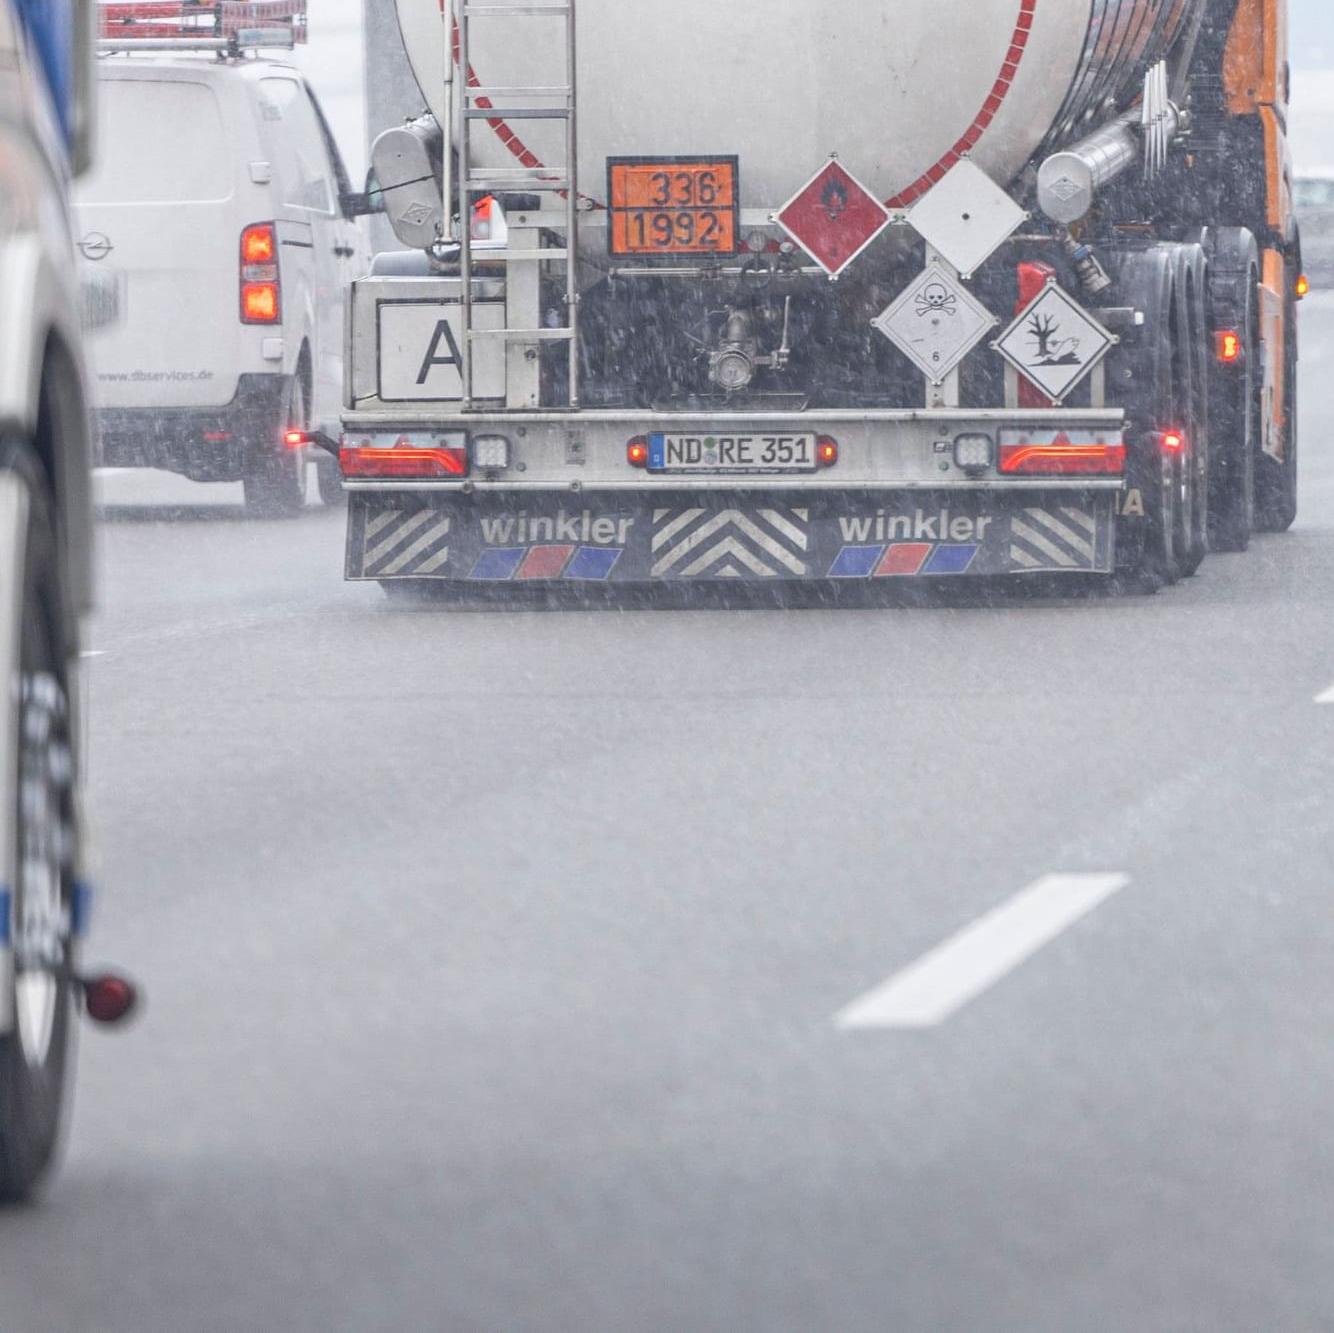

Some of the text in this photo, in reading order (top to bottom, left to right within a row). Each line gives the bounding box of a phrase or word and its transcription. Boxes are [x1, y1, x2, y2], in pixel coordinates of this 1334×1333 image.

[651, 171, 716, 206] 336
[633, 212, 719, 246] 1992
[416, 320, 464, 384] A
[666, 437, 810, 464] ND RE 351
[480, 508, 635, 544] winkler
[838, 508, 992, 542] winkler
